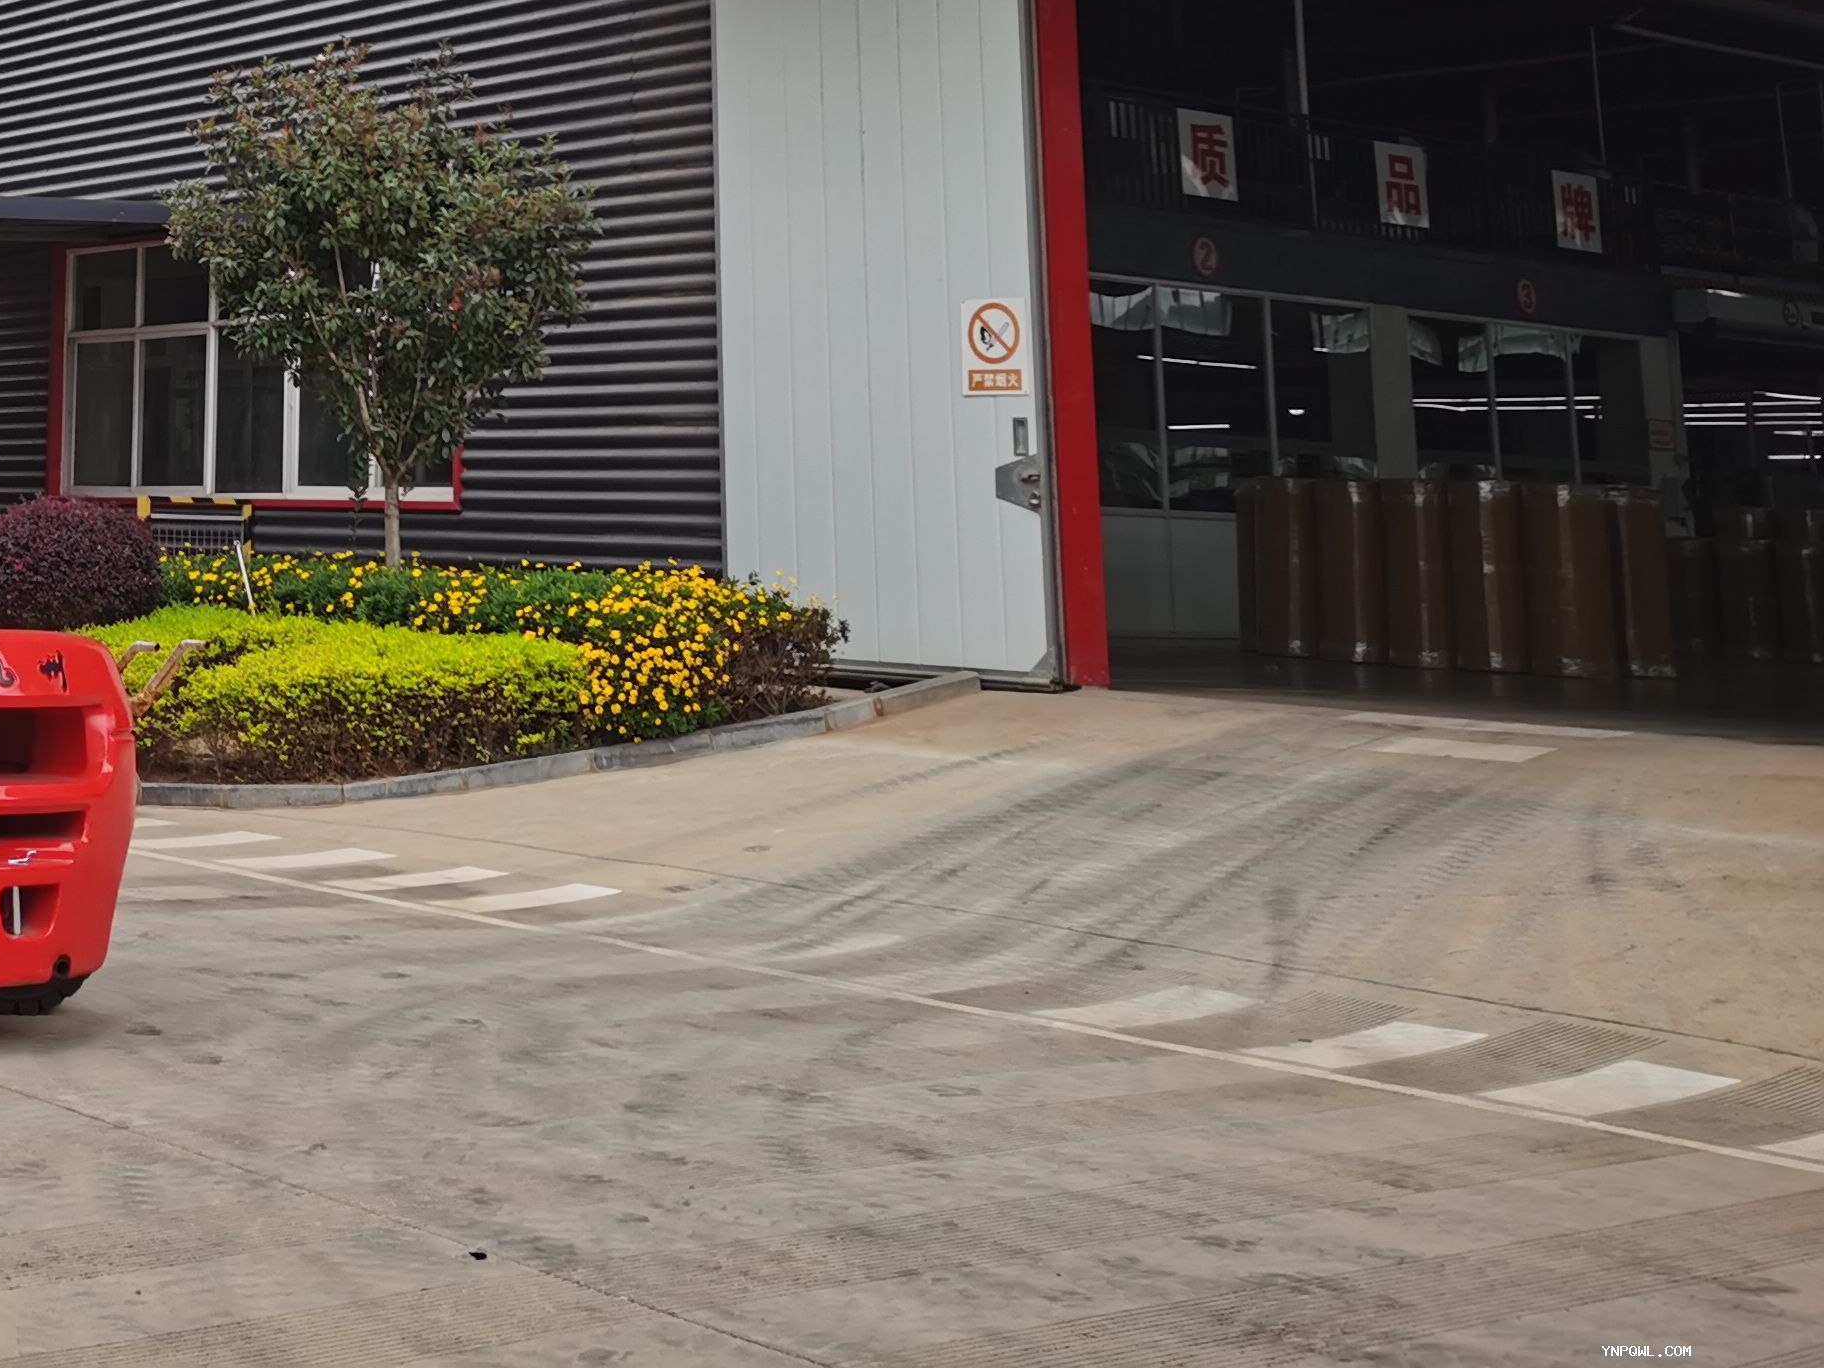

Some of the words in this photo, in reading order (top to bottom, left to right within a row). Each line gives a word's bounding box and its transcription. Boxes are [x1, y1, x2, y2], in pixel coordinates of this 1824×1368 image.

[1189, 122, 1230, 188] 质
[1386, 154, 1420, 216] 品
[1561, 184, 1596, 241] 牌
[971, 372, 1019, 388] 严禁烟火
